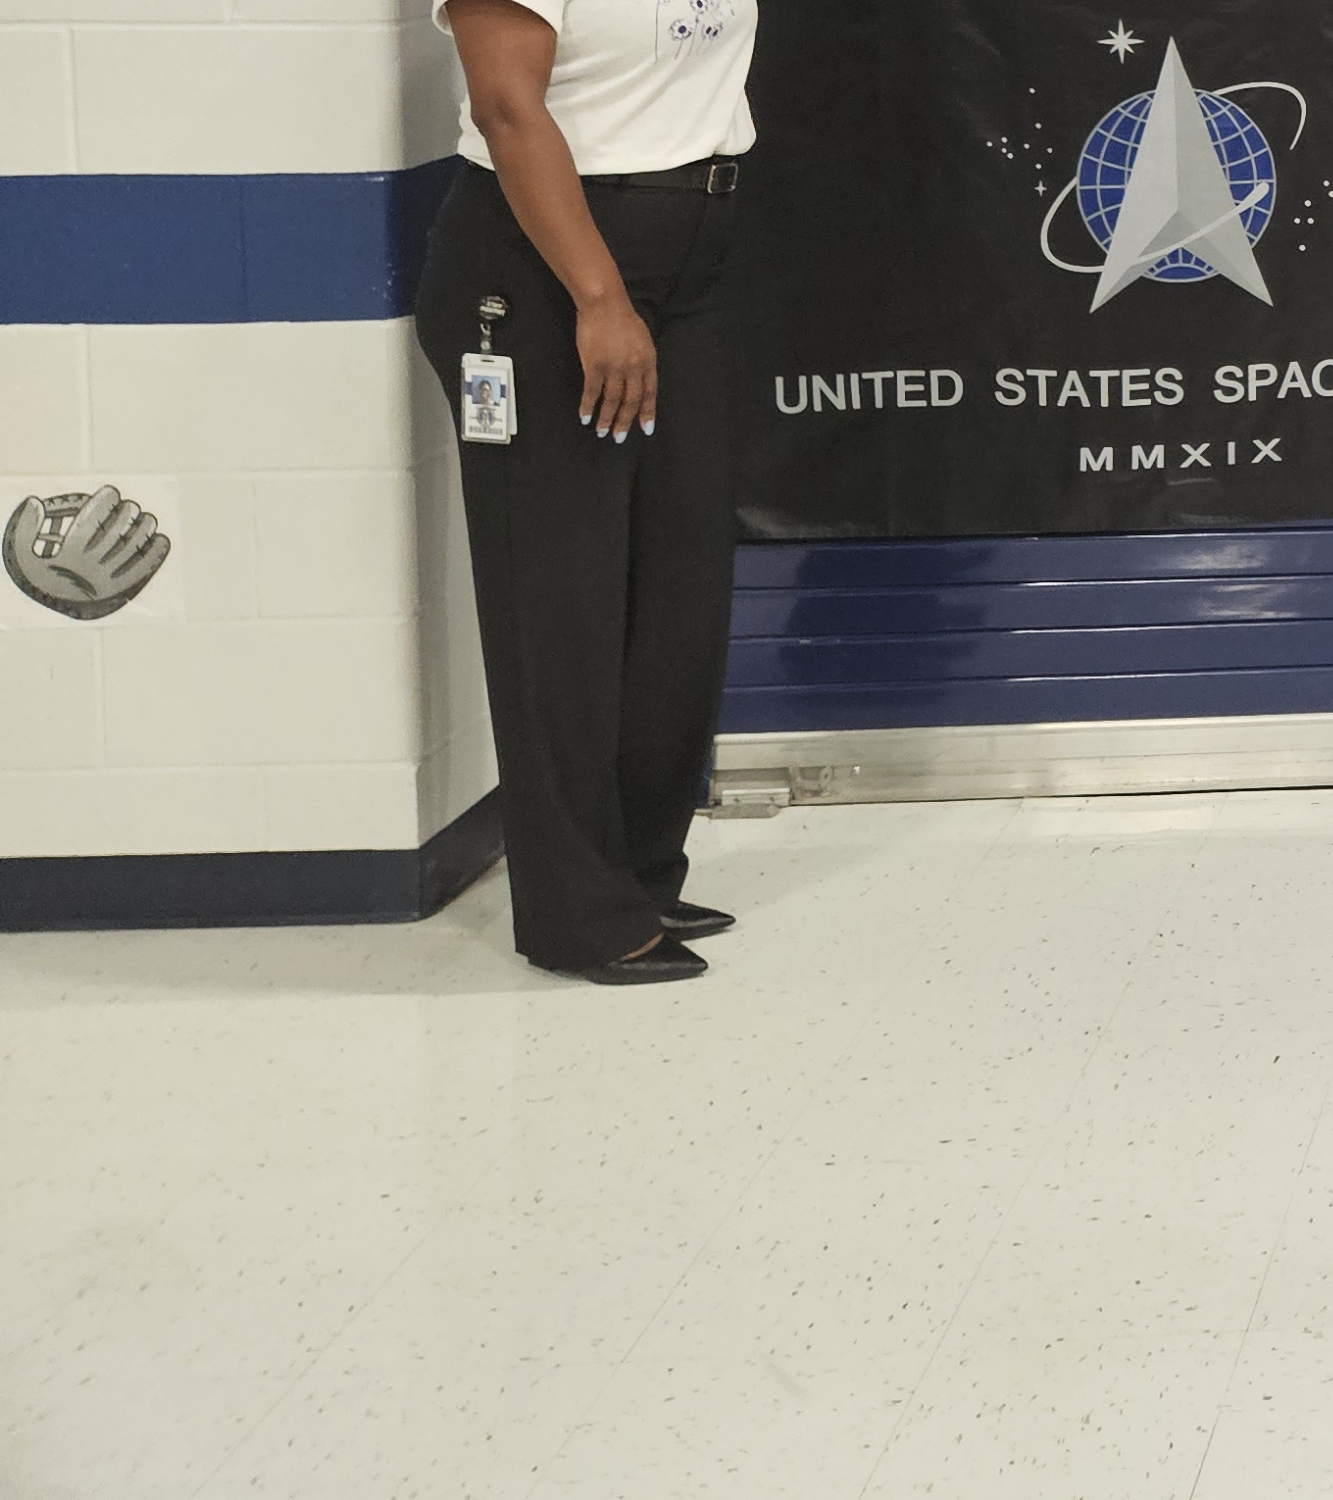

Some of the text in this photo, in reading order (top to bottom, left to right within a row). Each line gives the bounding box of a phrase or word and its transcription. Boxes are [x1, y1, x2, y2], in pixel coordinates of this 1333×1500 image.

[774, 369, 964, 415] UNITED
[994, 367, 1184, 408] STATES
[1078, 437, 1283, 473] MMXIX
